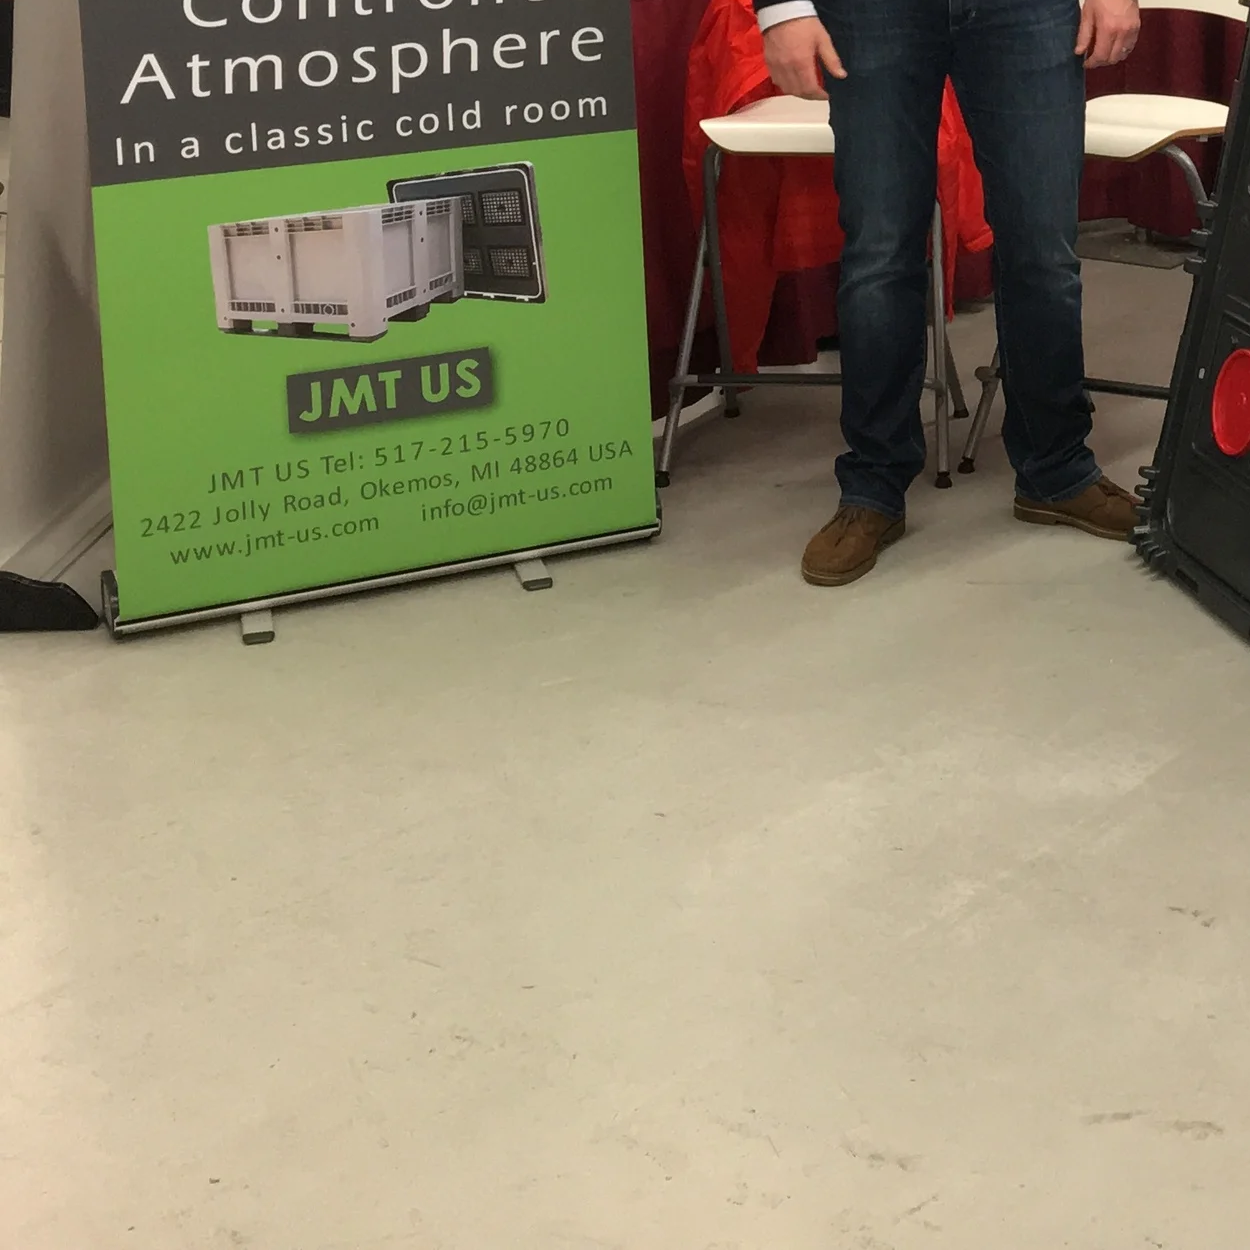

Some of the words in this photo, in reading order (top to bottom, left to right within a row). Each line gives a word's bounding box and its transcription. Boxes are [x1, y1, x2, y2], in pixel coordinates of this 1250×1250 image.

[120, 25, 604, 105] Atmosphere
[116, 137, 156, 166] In
[181, 138, 201, 160] a
[225, 114, 374, 155] classic
[395, 100, 482, 138] cold
[504, 93, 608, 127] room
[299, 370, 402, 422] JMT
[420, 357, 482, 403] US
[140, 510, 202, 538] 2422
[212, 497, 270, 528] Jolly
[283, 484, 350, 514] Road,
[360, 472, 460, 502] Okemos,
[471, 460, 501, 482] MI
[509, 448, 579, 476] 48864
[588, 440, 633, 462] USA
[207, 466, 263, 494] JMT
[275, 460, 310, 484] US
[320, 452, 364, 477] Tel:
[374, 418, 570, 467] 517-215-5970
[170, 515, 379, 565] www.jmt-us.com
[421, 475, 613, 523] info@jmt-us.com
